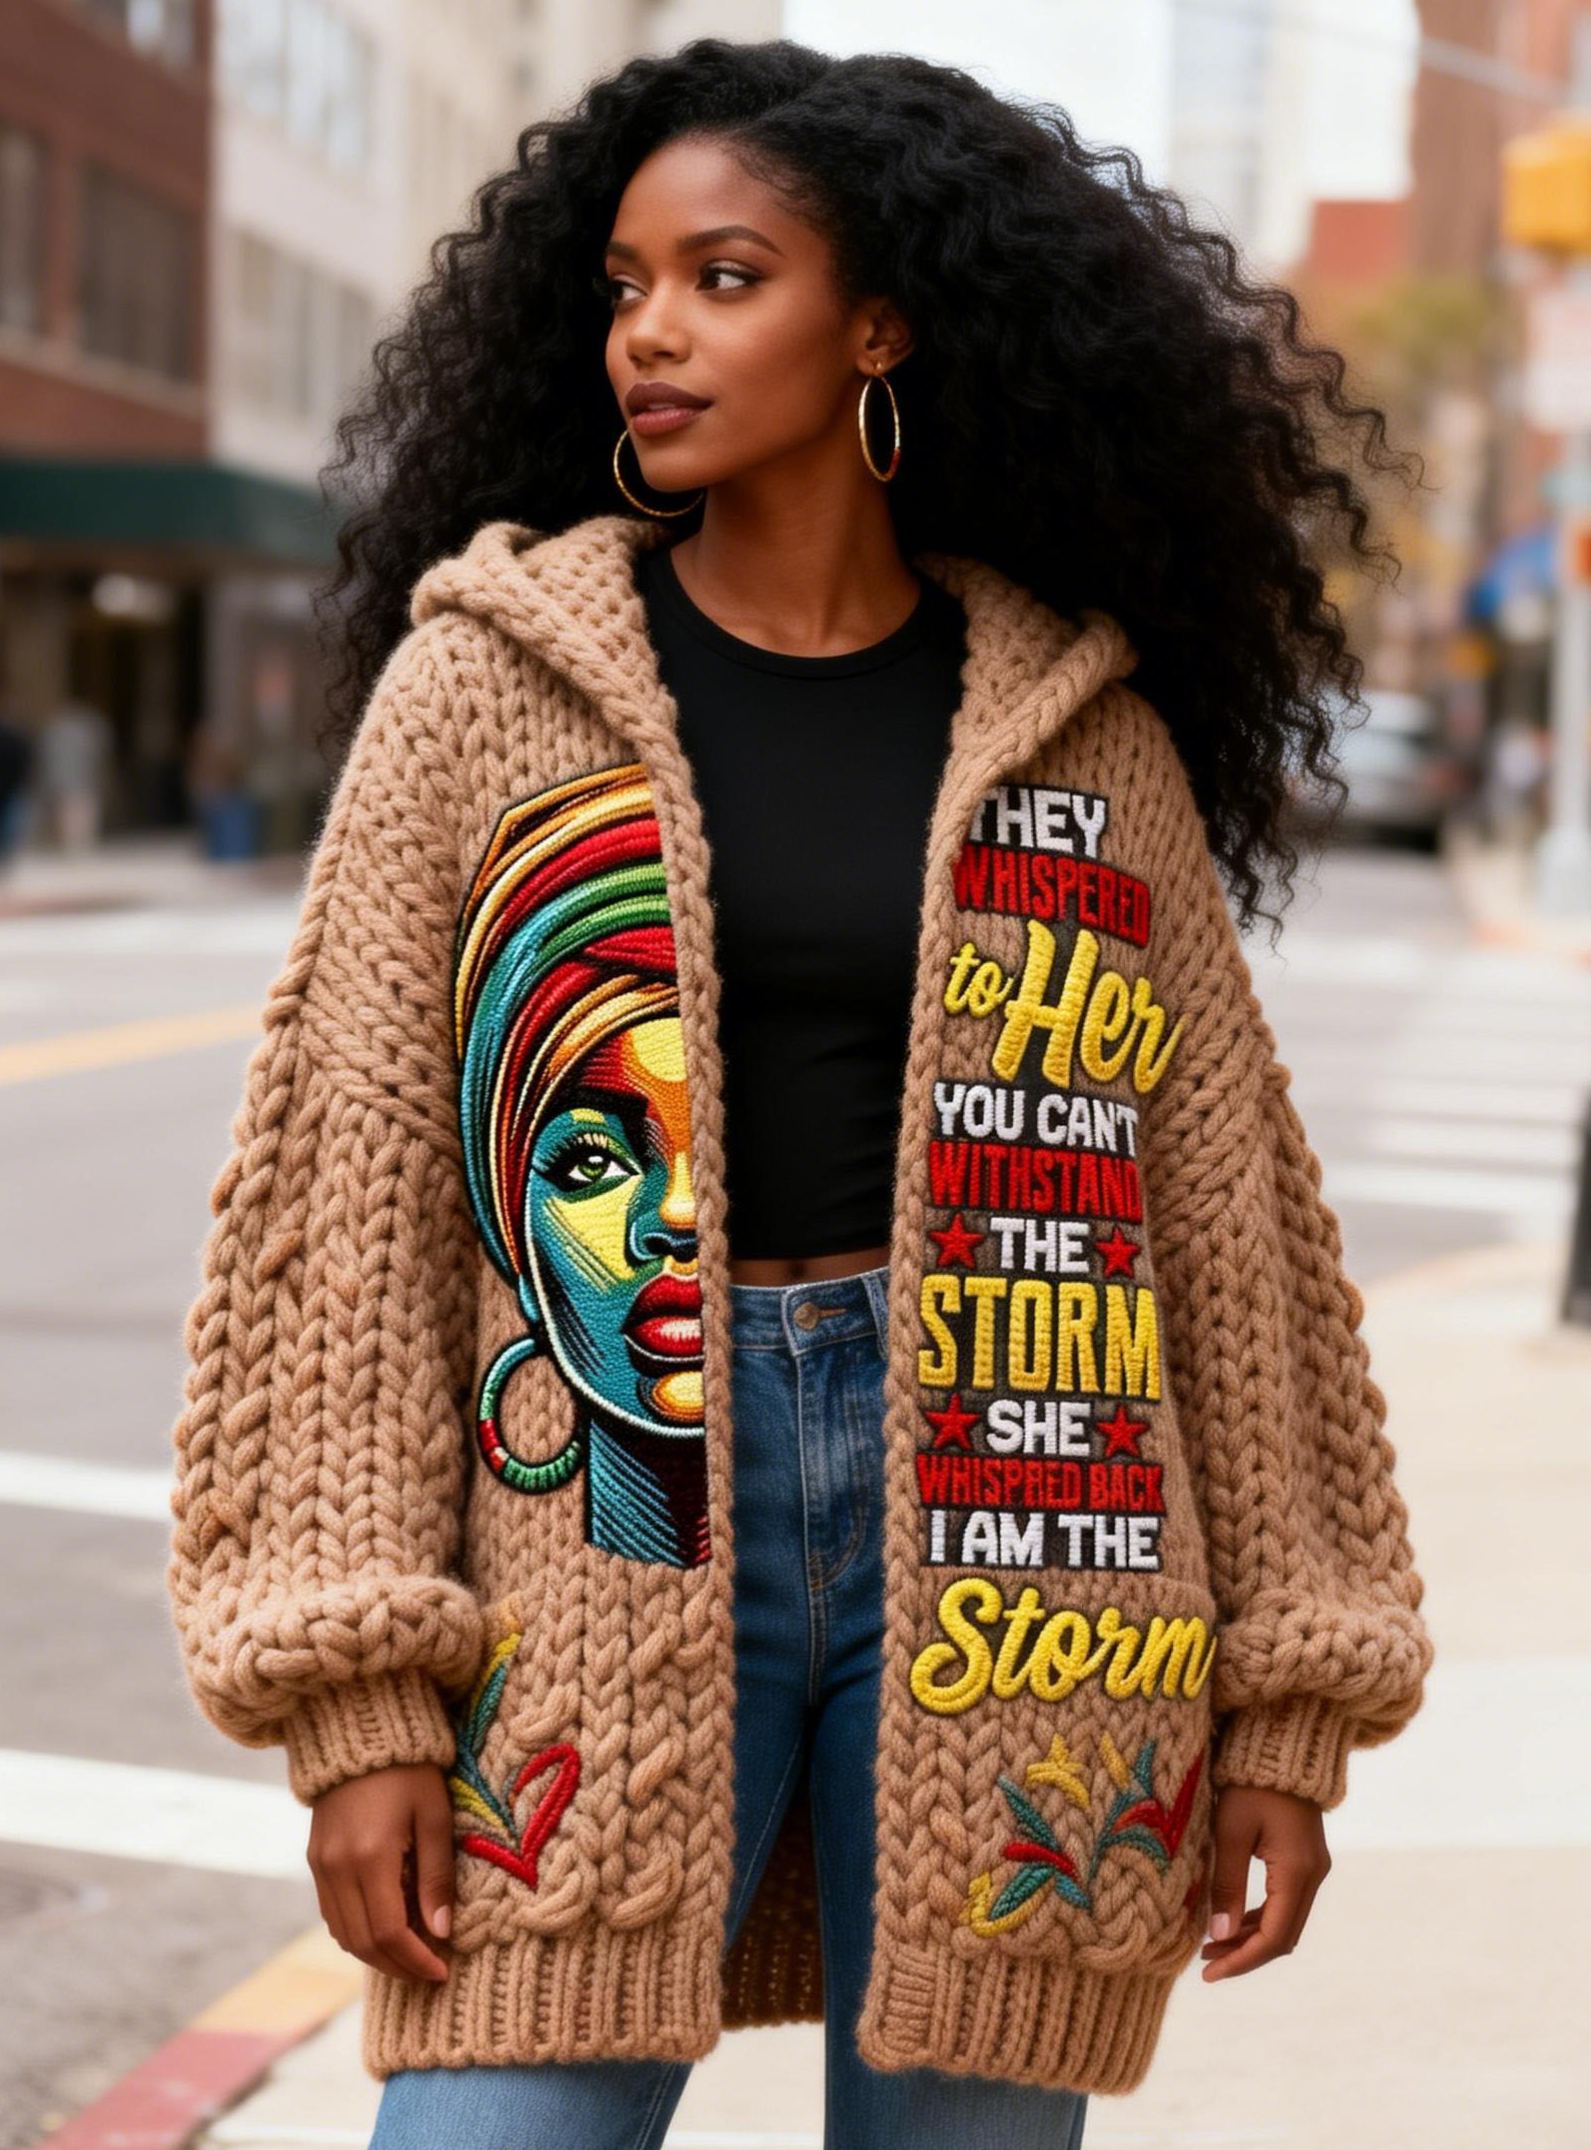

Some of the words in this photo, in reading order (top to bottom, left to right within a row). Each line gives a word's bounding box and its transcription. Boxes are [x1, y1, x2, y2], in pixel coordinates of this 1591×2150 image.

[969, 786, 1106, 858] THEY
[952, 846, 1150, 948] WHISPERED
[944, 943, 1014, 1018] to
[992, 919, 1188, 1093] Her
[934, 1083, 1025, 1140] YOU
[929, 1141, 1143, 1224] WITHSTAND
[990, 1217, 1090, 1273] THE
[918, 1274, 1162, 1399] STORM
[986, 1399, 1091, 1456] SHE
[1089, 1464, 1165, 1512] BACK
[930, 1510, 946, 1563] I
[961, 1511, 1044, 1567] AM
[1058, 1514, 1159, 1569] THE
[910, 1578, 1218, 1714] Storm
